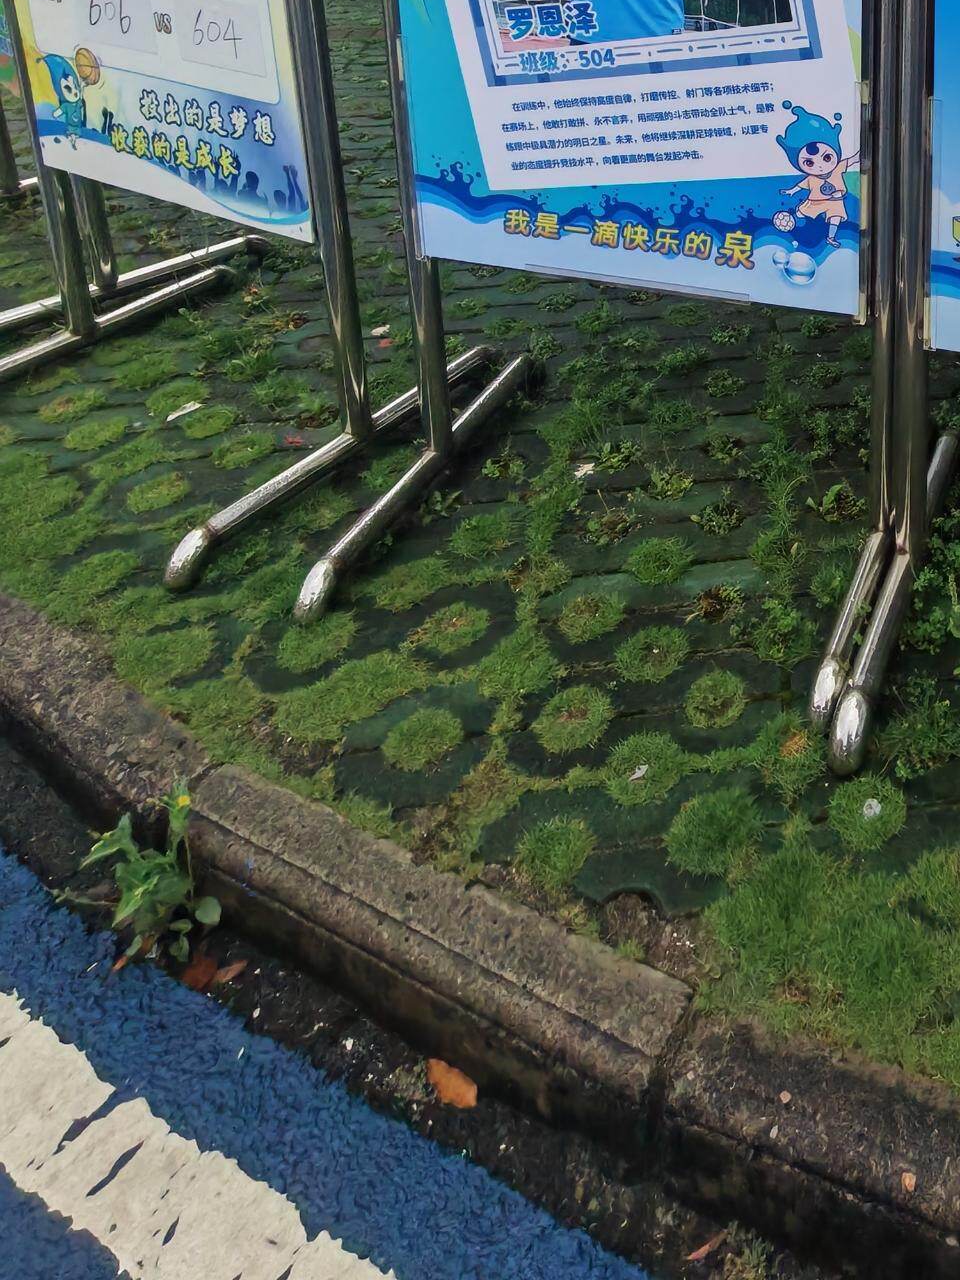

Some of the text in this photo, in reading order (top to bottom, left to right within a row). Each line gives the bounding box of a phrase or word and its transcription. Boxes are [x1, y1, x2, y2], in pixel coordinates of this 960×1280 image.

[192, 9, 243, 60] 604
[505, 1, 598, 40] 罗恩泽
[139, 89, 276, 146] 投出的是梦想
[110, 122, 241, 179] 收获的是成长
[504, 208, 755, 269] 我是一滴快乐的泉
